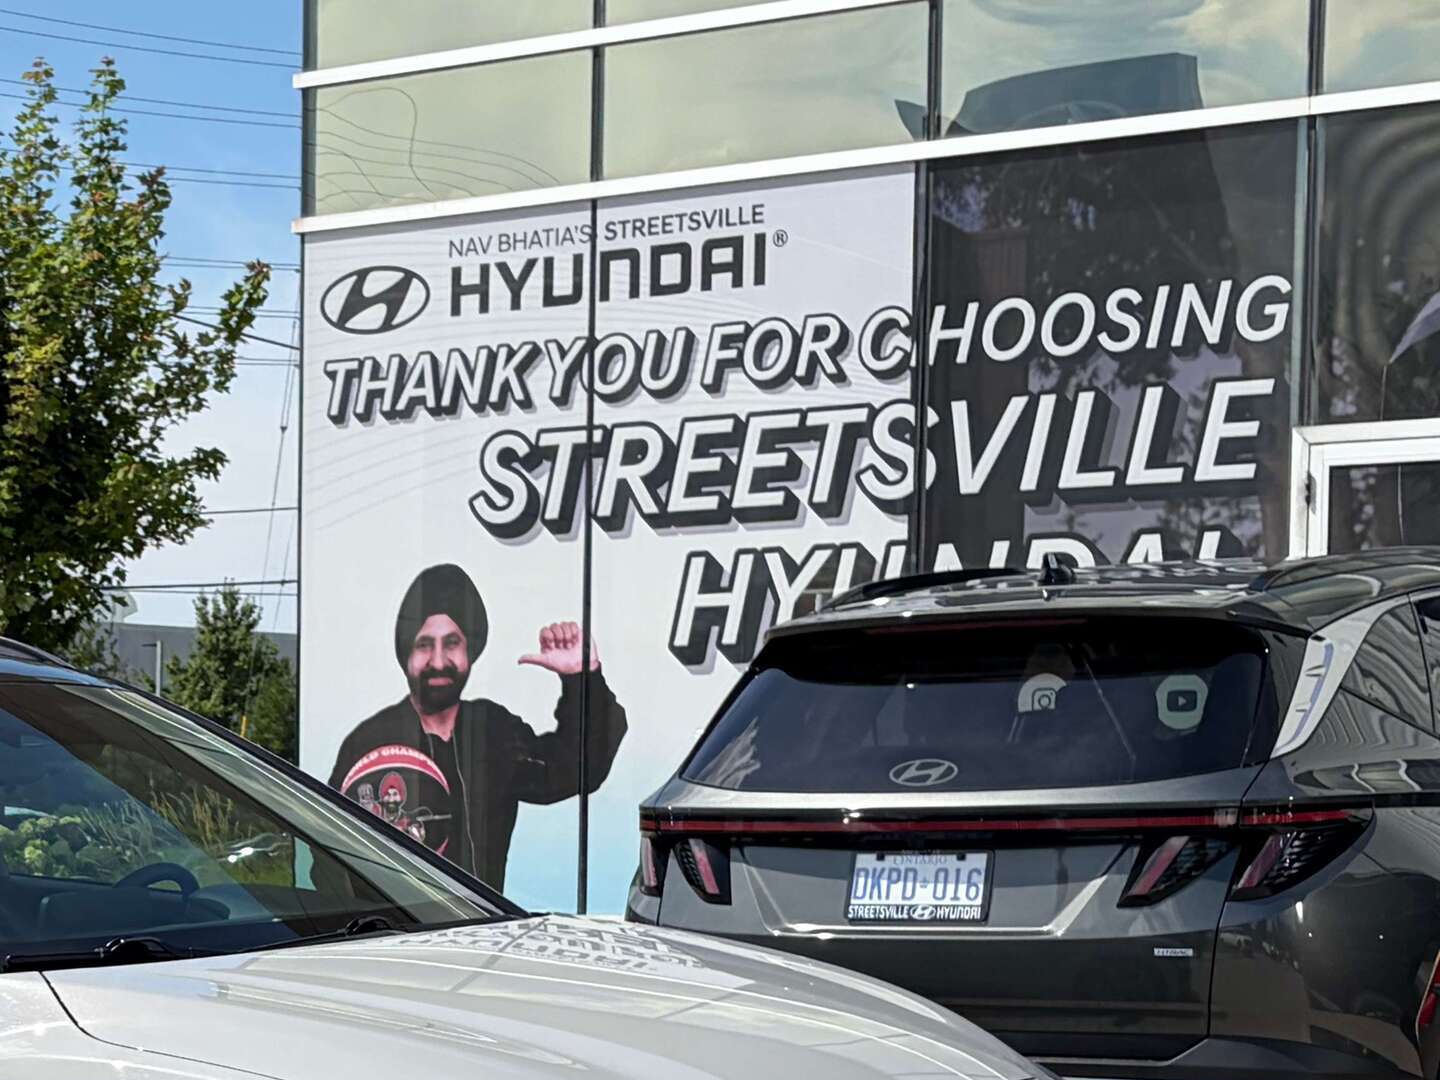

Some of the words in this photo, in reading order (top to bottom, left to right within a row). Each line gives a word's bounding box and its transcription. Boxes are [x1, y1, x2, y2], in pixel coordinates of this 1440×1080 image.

[447, 234, 493, 259] NAV
[497, 223, 597, 253] BHATIA'S
[603, 203, 766, 242] STREETSVILLE
[324, 342, 538, 426] THANK
[545, 327, 696, 404] YOU
[701, 313, 848, 394] FOR
[859, 273, 1292, 374] CHOOSING
[468, 377, 1276, 541] STREETSVILLE
[847, 904, 910, 919] STREETSVILLE
[935, 905, 982, 920] HYUNDAI
